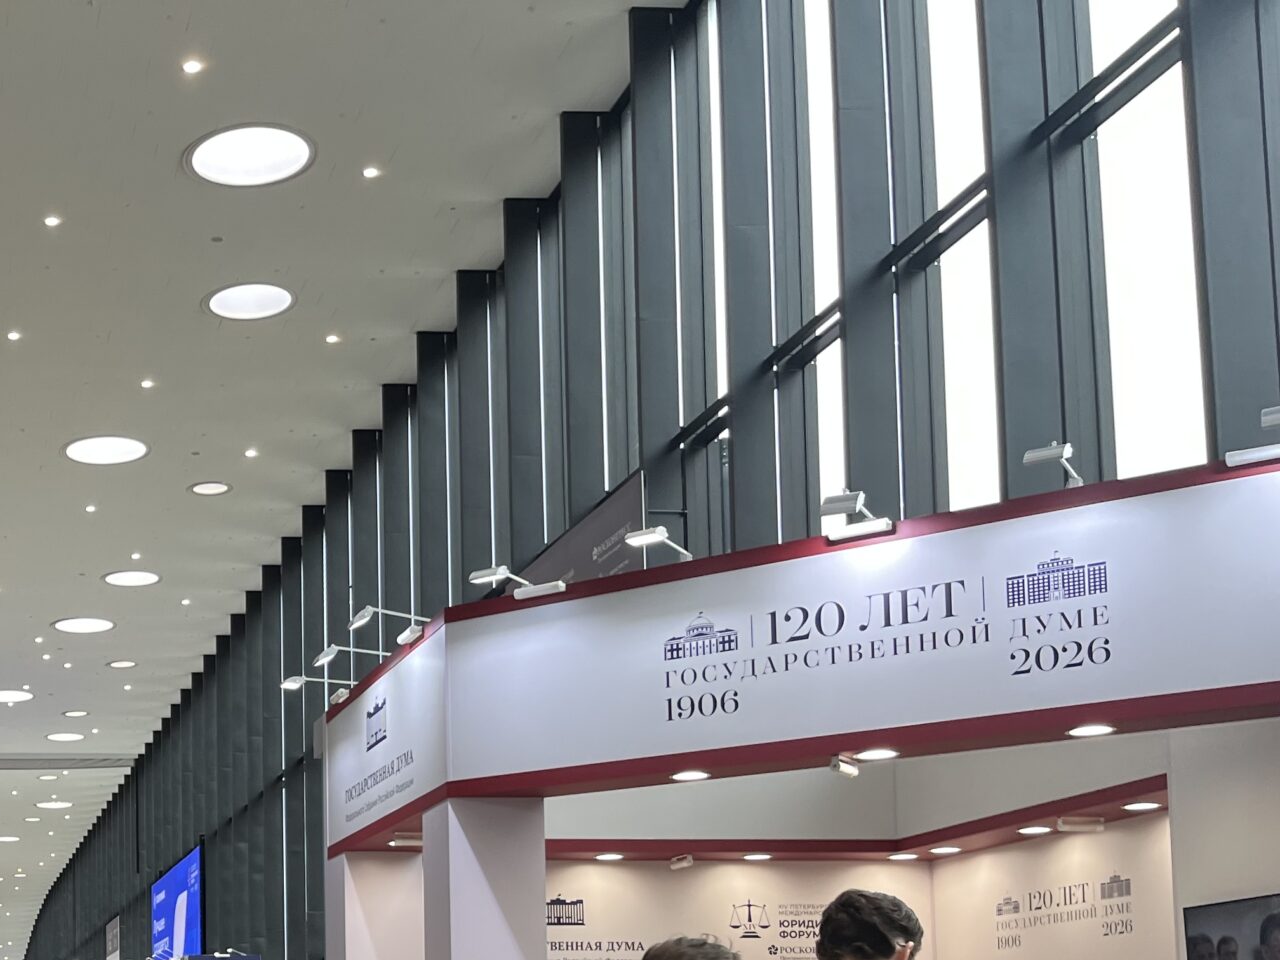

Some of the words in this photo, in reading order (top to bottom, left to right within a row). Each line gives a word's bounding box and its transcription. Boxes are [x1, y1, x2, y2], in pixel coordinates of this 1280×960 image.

[766, 600, 846, 646] 120
[859, 579, 967, 632] ЛЕТ
[665, 617, 991, 689] ГОСУДАРСТВЕННОЙ
[1009, 605, 1110, 643] ДУМЕ
[665, 689, 739, 722] 1906
[1009, 636, 1111, 676] 2026
[345, 759, 395, 804] ГОСУДАРСТВЕННАЯ
[395, 749, 414, 776] ДУМА
[1027, 888, 1053, 911] 120
[1056, 882, 1089, 907] ЛЕТ
[996, 904, 1097, 932] ГОСУДАРСТВЕННОЙ
[1101, 902, 1133, 918] ДУМЕ
[547, 941, 602, 951] ВЕННАЯ
[606, 941, 645, 952] ДУМА
[779, 930, 820, 939] ФОРУМ
[997, 935, 1021, 950] 1906
[1102, 919, 1133, 936] 2026
